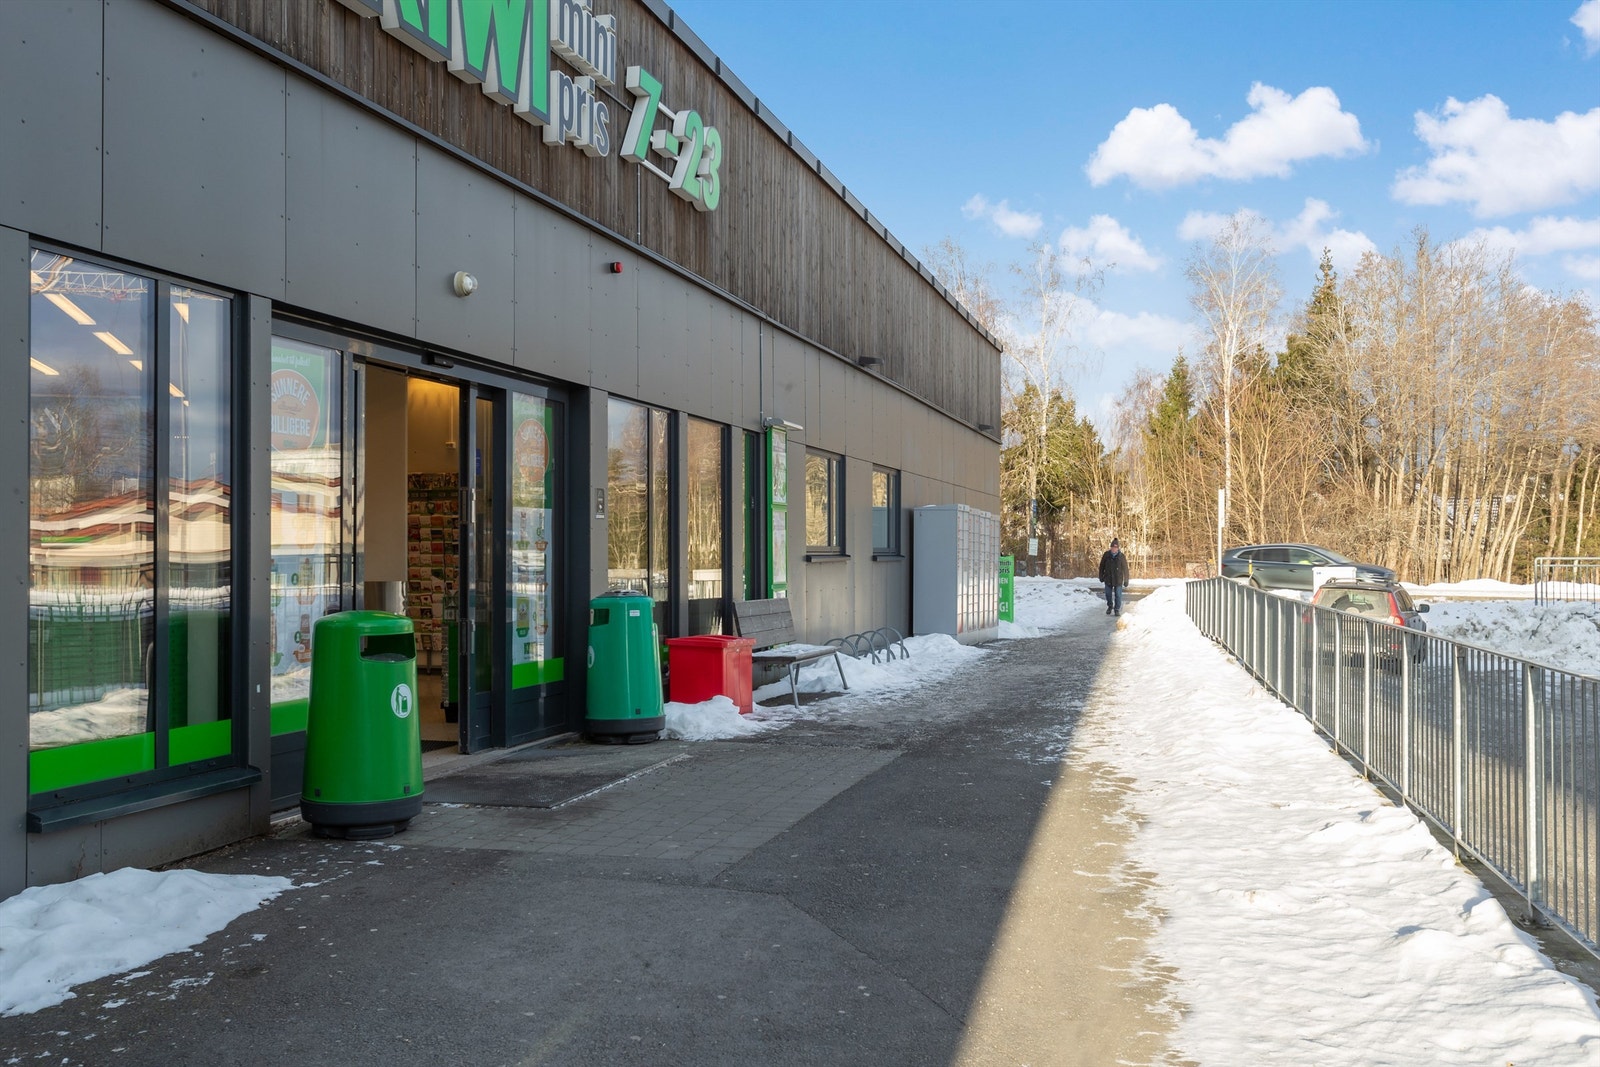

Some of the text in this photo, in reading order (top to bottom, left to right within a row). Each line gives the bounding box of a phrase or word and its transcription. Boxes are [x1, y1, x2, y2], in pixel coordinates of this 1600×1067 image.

[555, 0, 616, 85] mini
[556, 70, 610, 157] pris
[629, 66, 722, 211] 7-23
